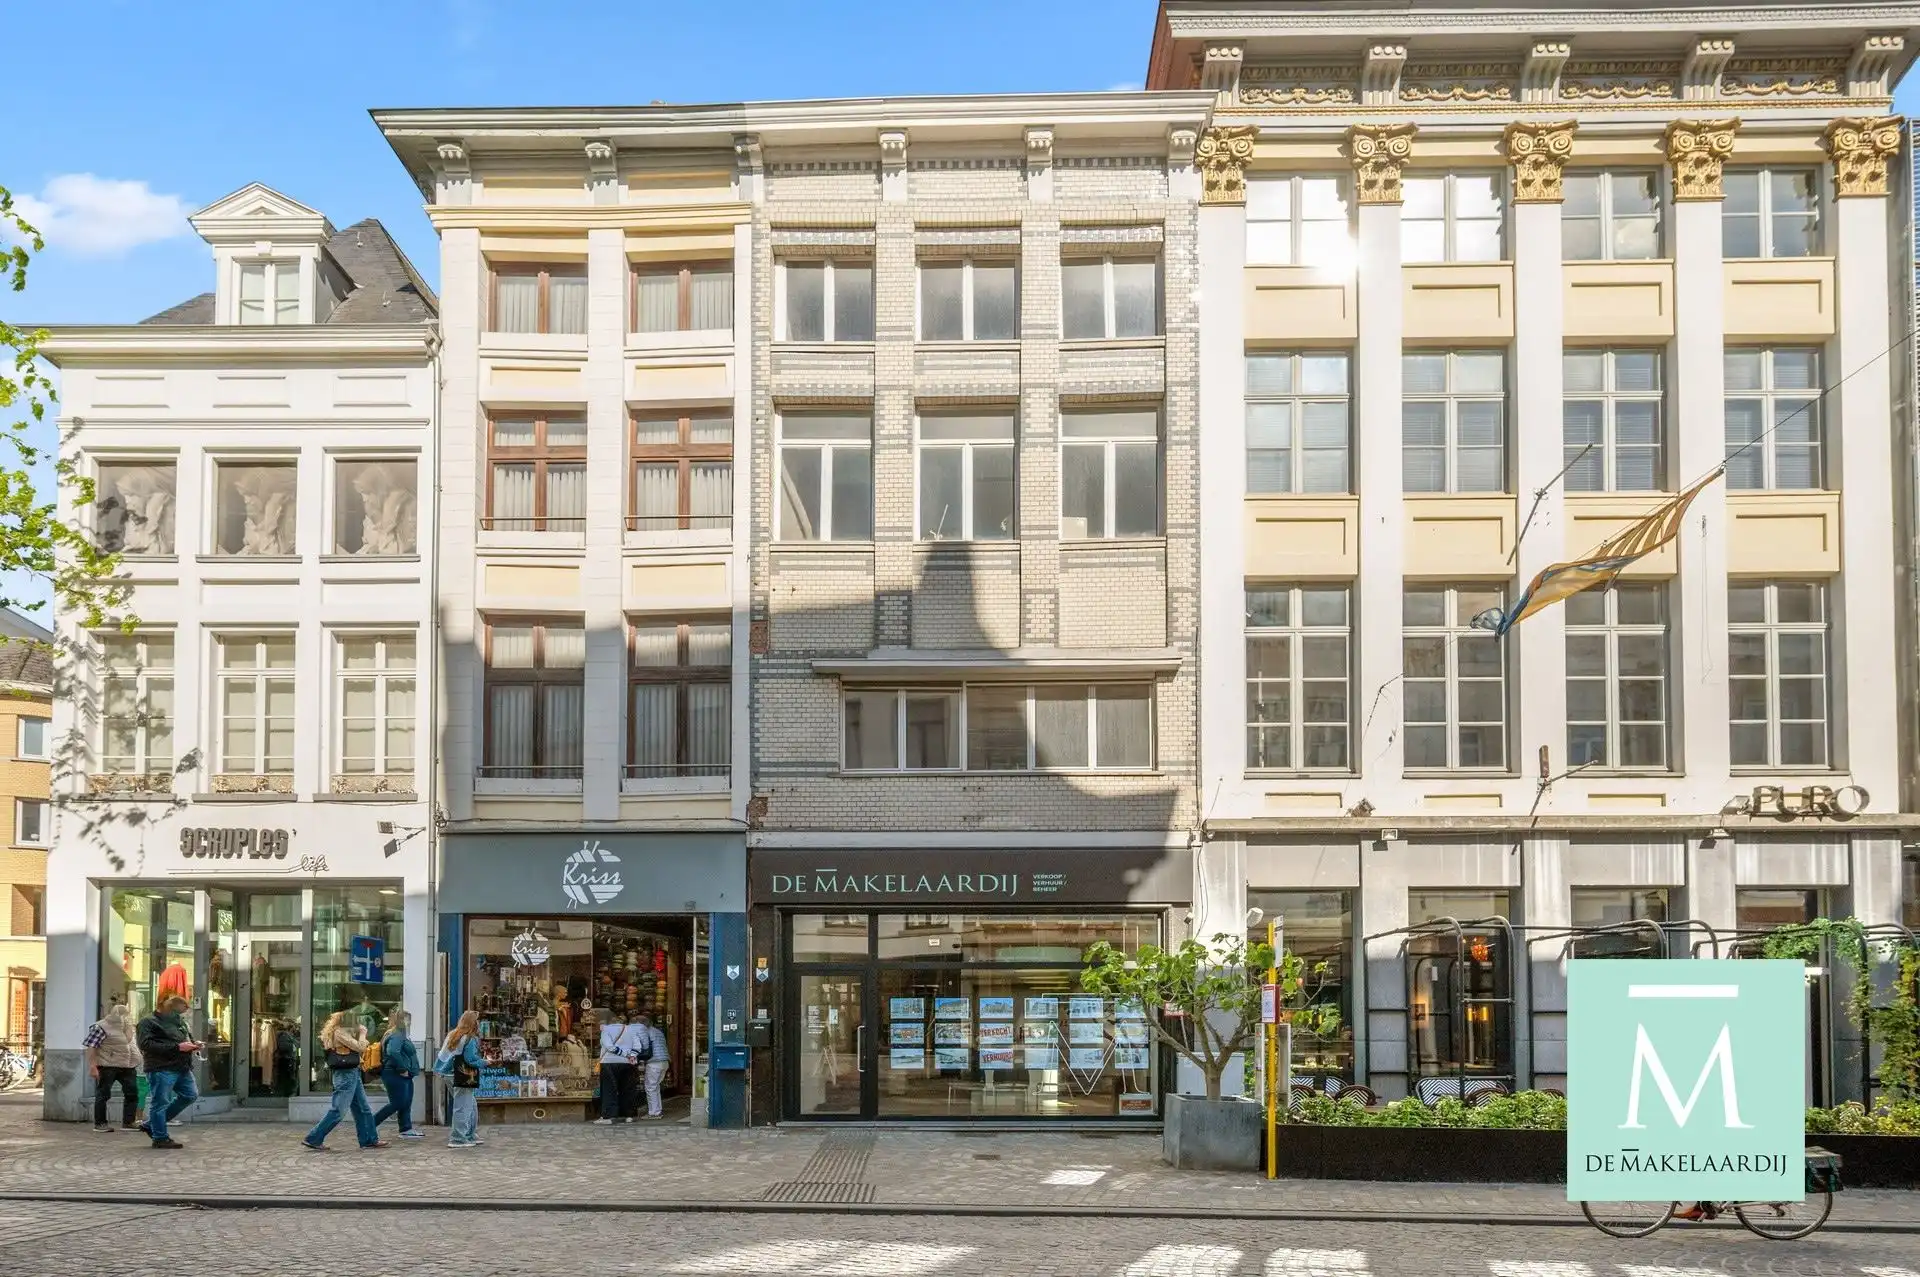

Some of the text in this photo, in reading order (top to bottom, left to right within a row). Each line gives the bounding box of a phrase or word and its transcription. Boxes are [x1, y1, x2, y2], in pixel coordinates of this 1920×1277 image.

[1752, 785, 1870, 822] PURO
[563, 862, 621, 885] Kriss
[772, 868, 1018, 897] DE MAKELAARDIJ
[512, 940, 549, 954] Kriss
